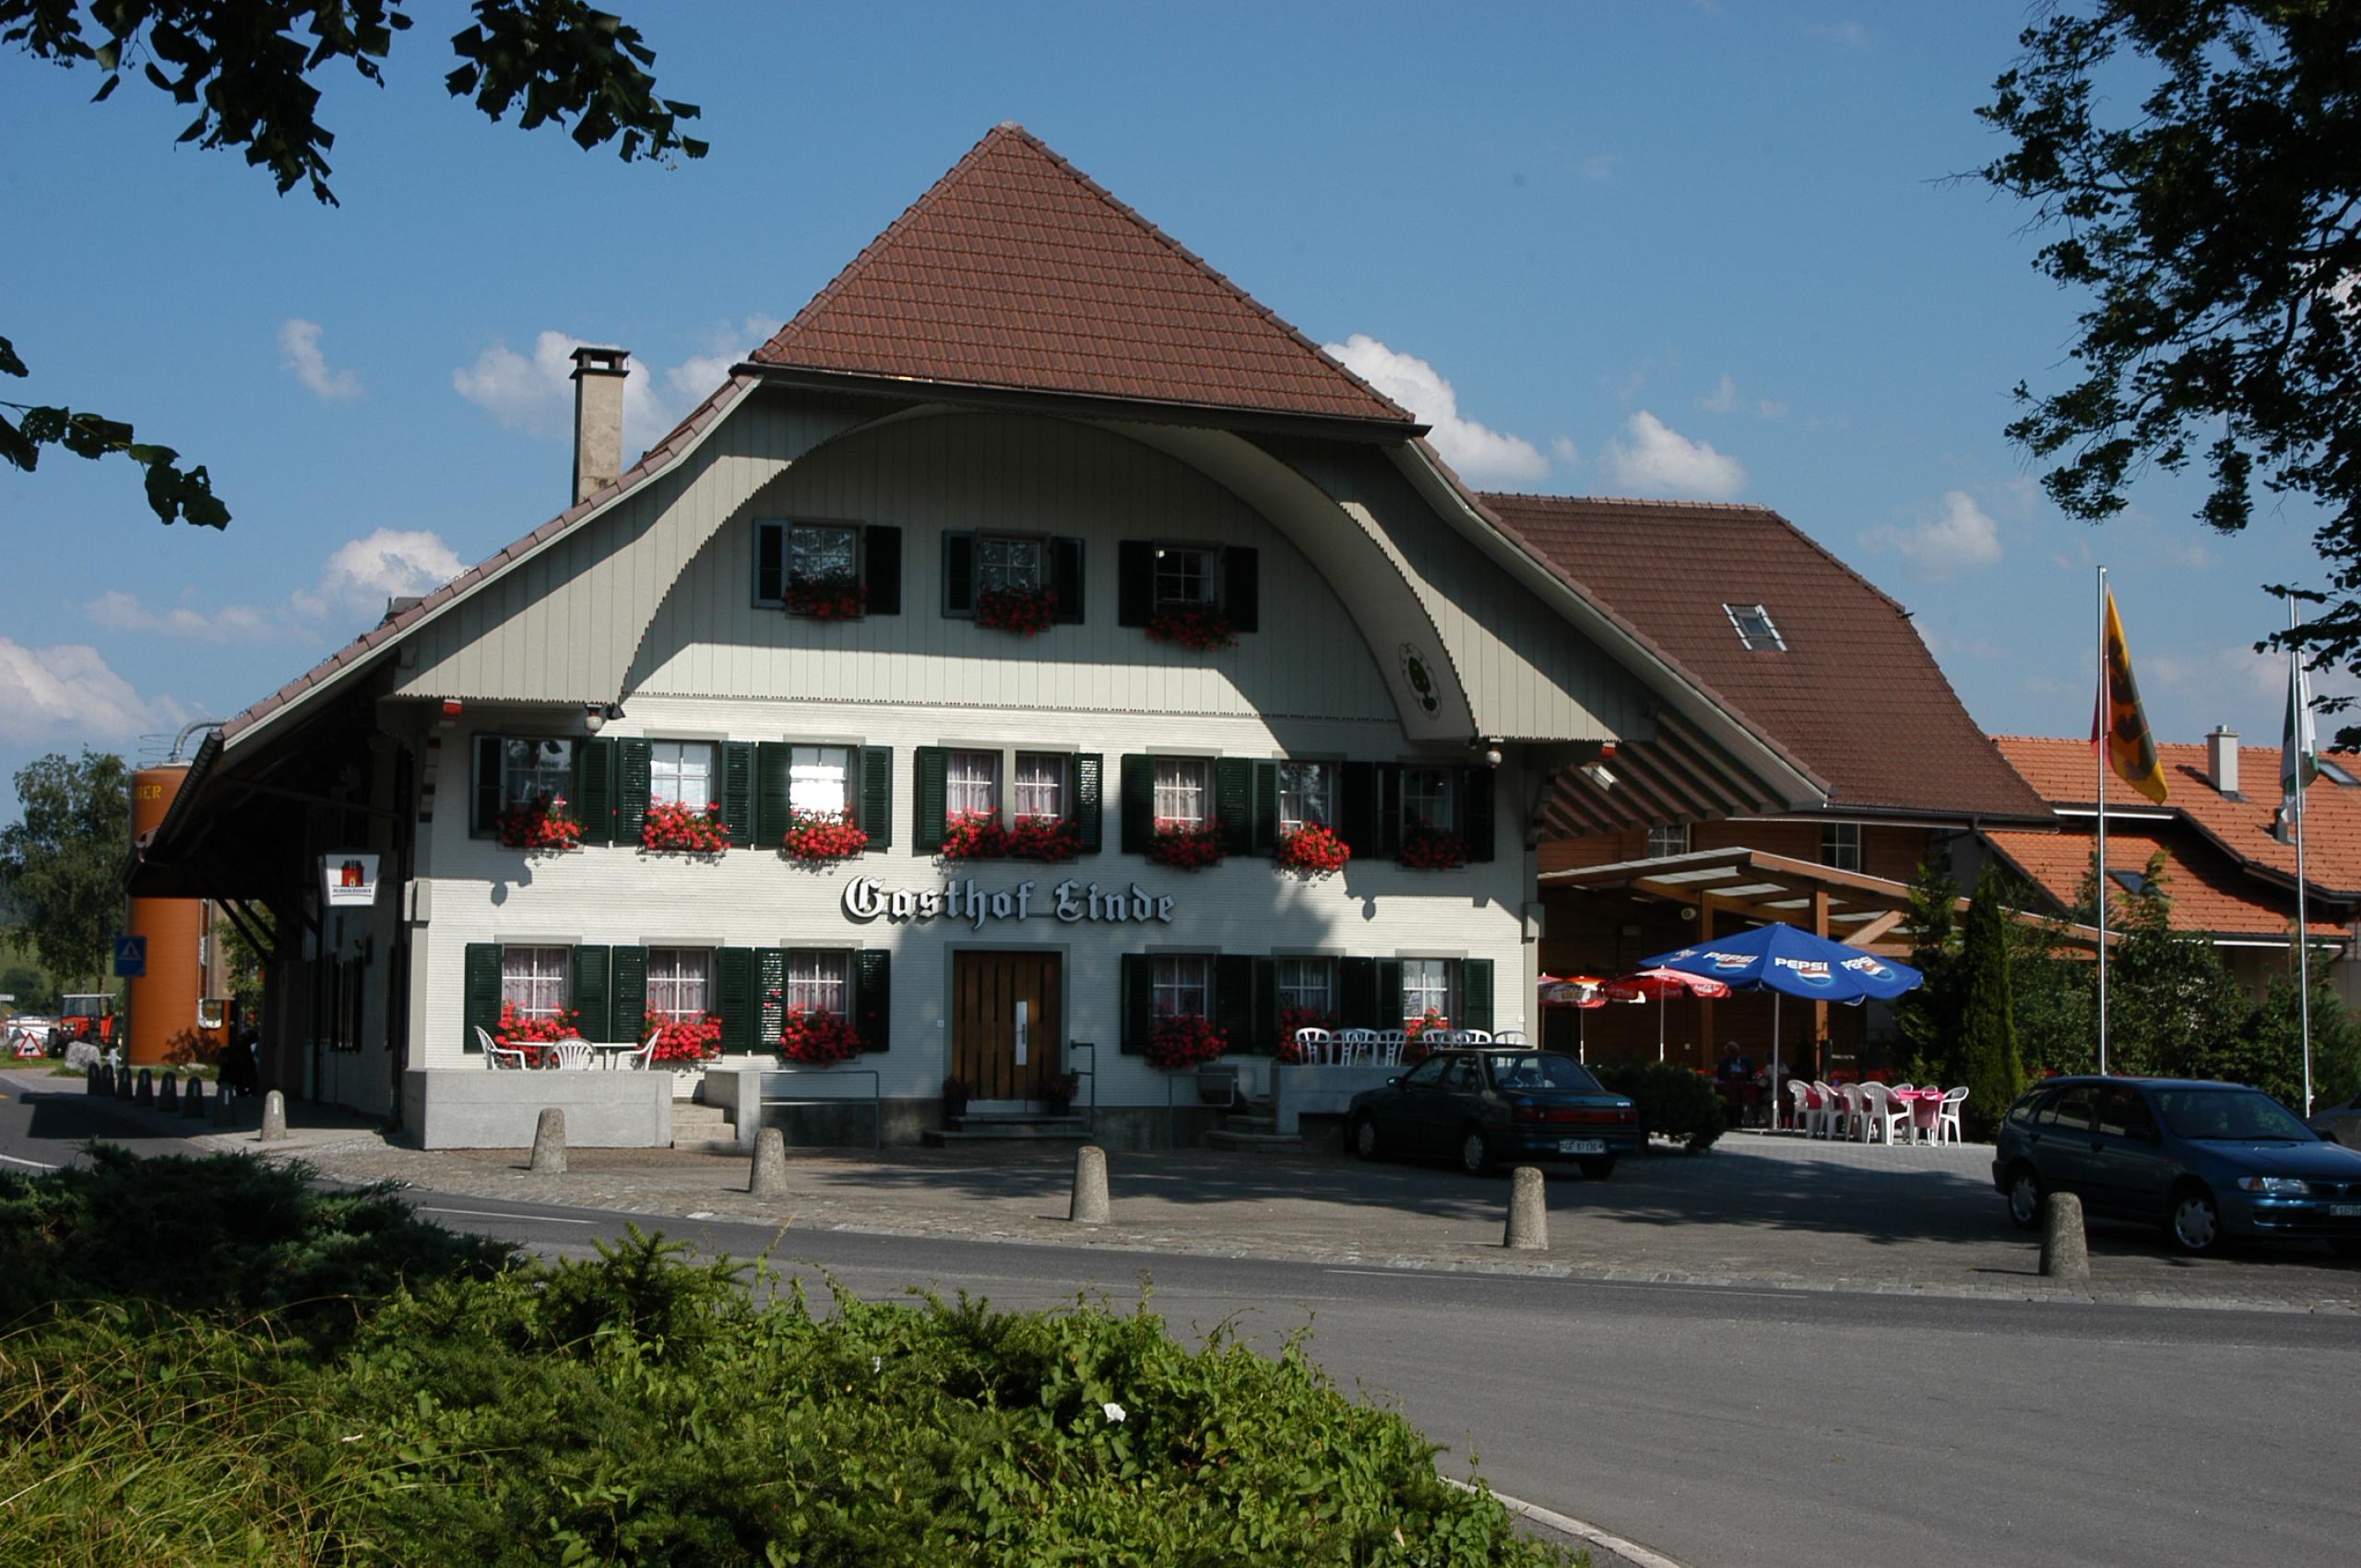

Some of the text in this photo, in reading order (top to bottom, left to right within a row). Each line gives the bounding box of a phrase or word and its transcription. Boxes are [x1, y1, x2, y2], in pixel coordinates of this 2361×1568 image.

[843, 874, 1175, 930] Gasthof Linde
[1703, 951, 1759, 965] PEPSI
[1774, 956, 1828, 971] PEPSI
